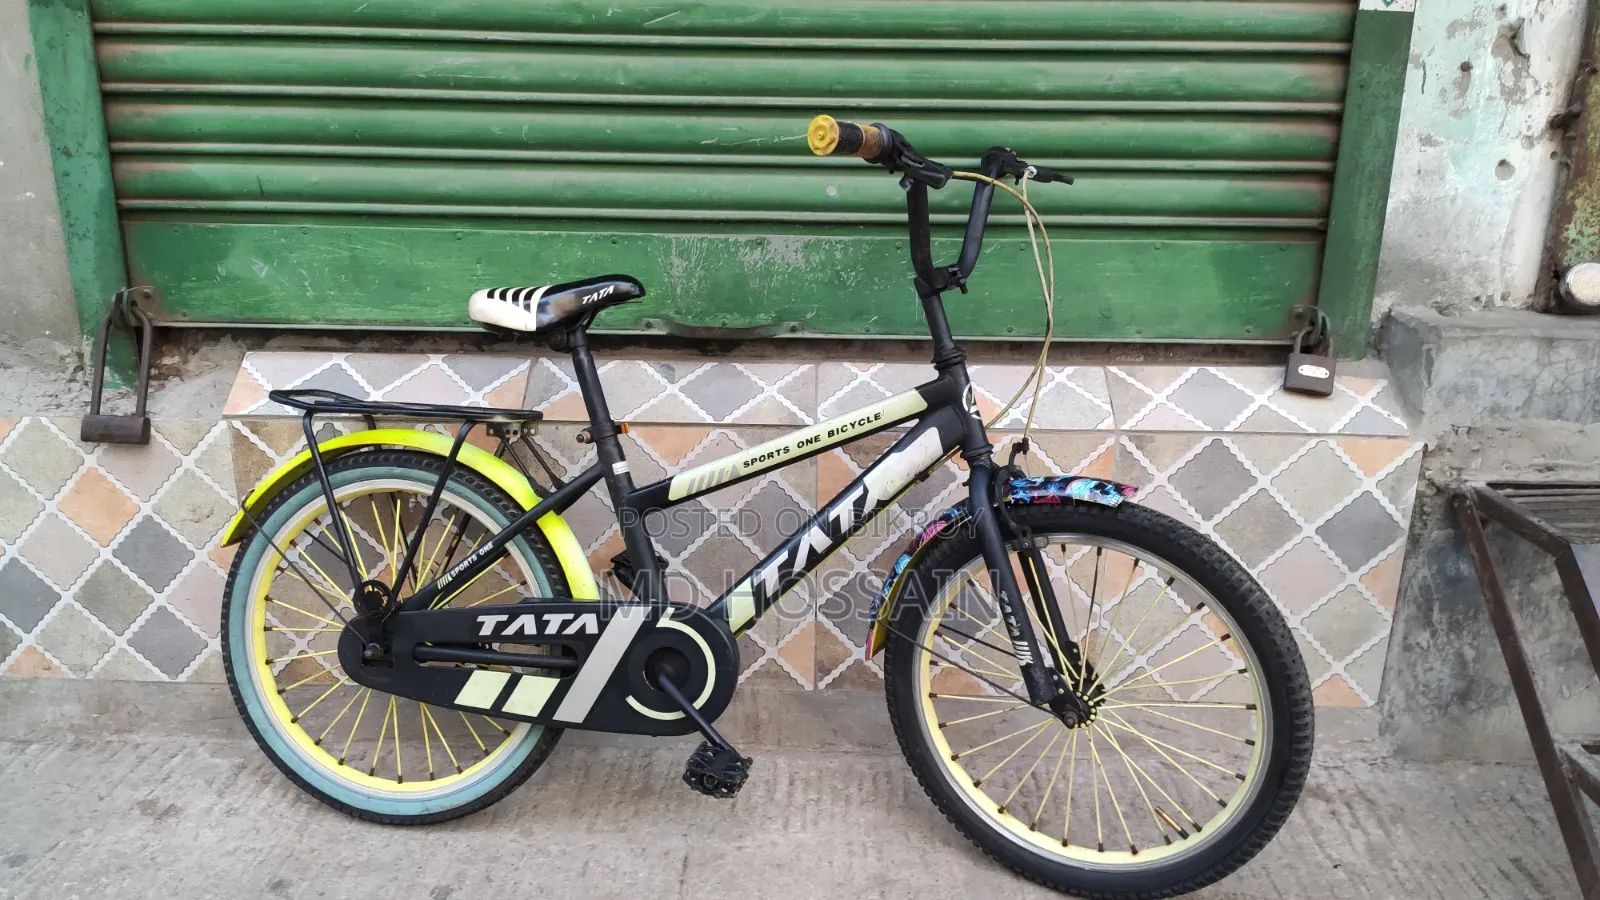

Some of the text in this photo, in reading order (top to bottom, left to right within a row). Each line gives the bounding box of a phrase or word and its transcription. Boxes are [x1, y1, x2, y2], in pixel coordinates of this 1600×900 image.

[582, 285, 615, 305] TATA
[742, 412, 882, 468] SPORTS ONE BICYCLE
[451, 542, 494, 577] SPORTS ONE
[476, 613, 600, 636] TATA
